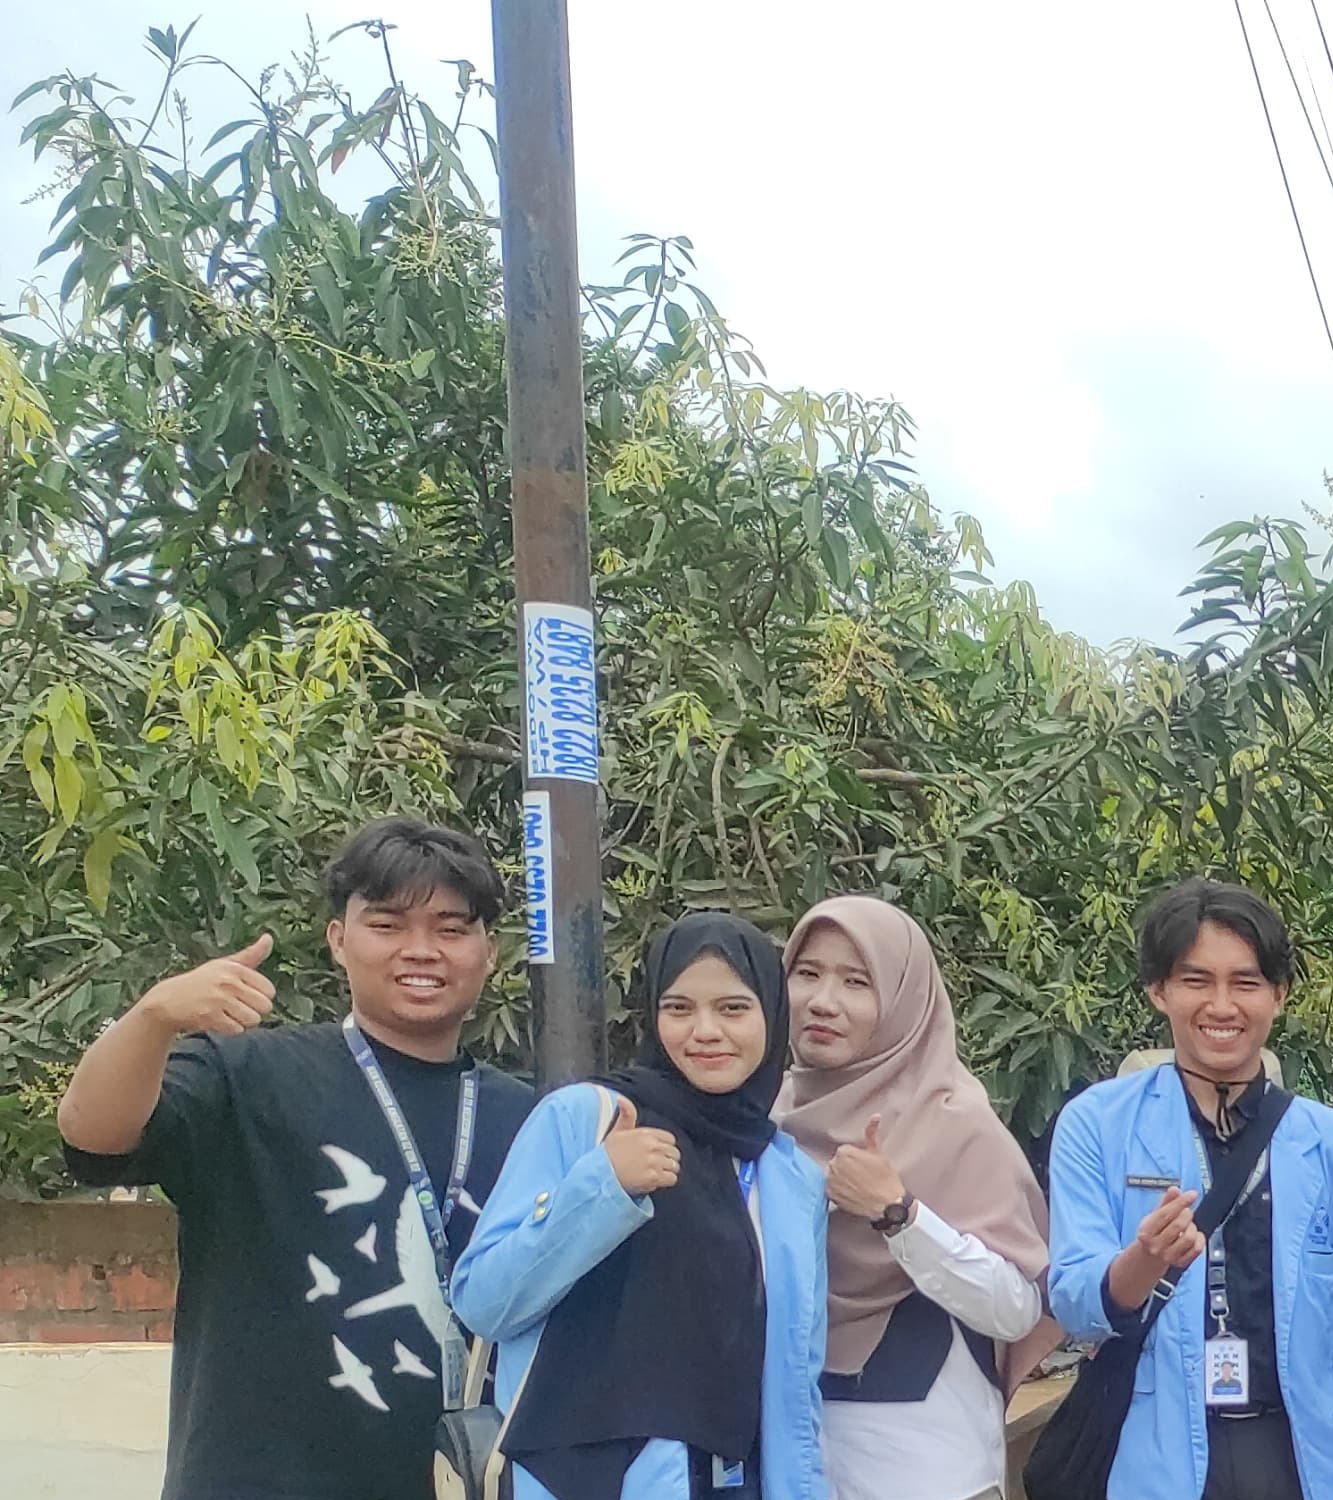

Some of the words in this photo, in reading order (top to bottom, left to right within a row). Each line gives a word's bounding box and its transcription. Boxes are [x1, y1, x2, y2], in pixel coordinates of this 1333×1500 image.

[534, 617, 548, 686] WA
[547, 617, 593, 672] 8487
[549, 673, 596, 727] 8235
[538, 720, 550, 774] HP
[551, 729, 598, 780] 0822
